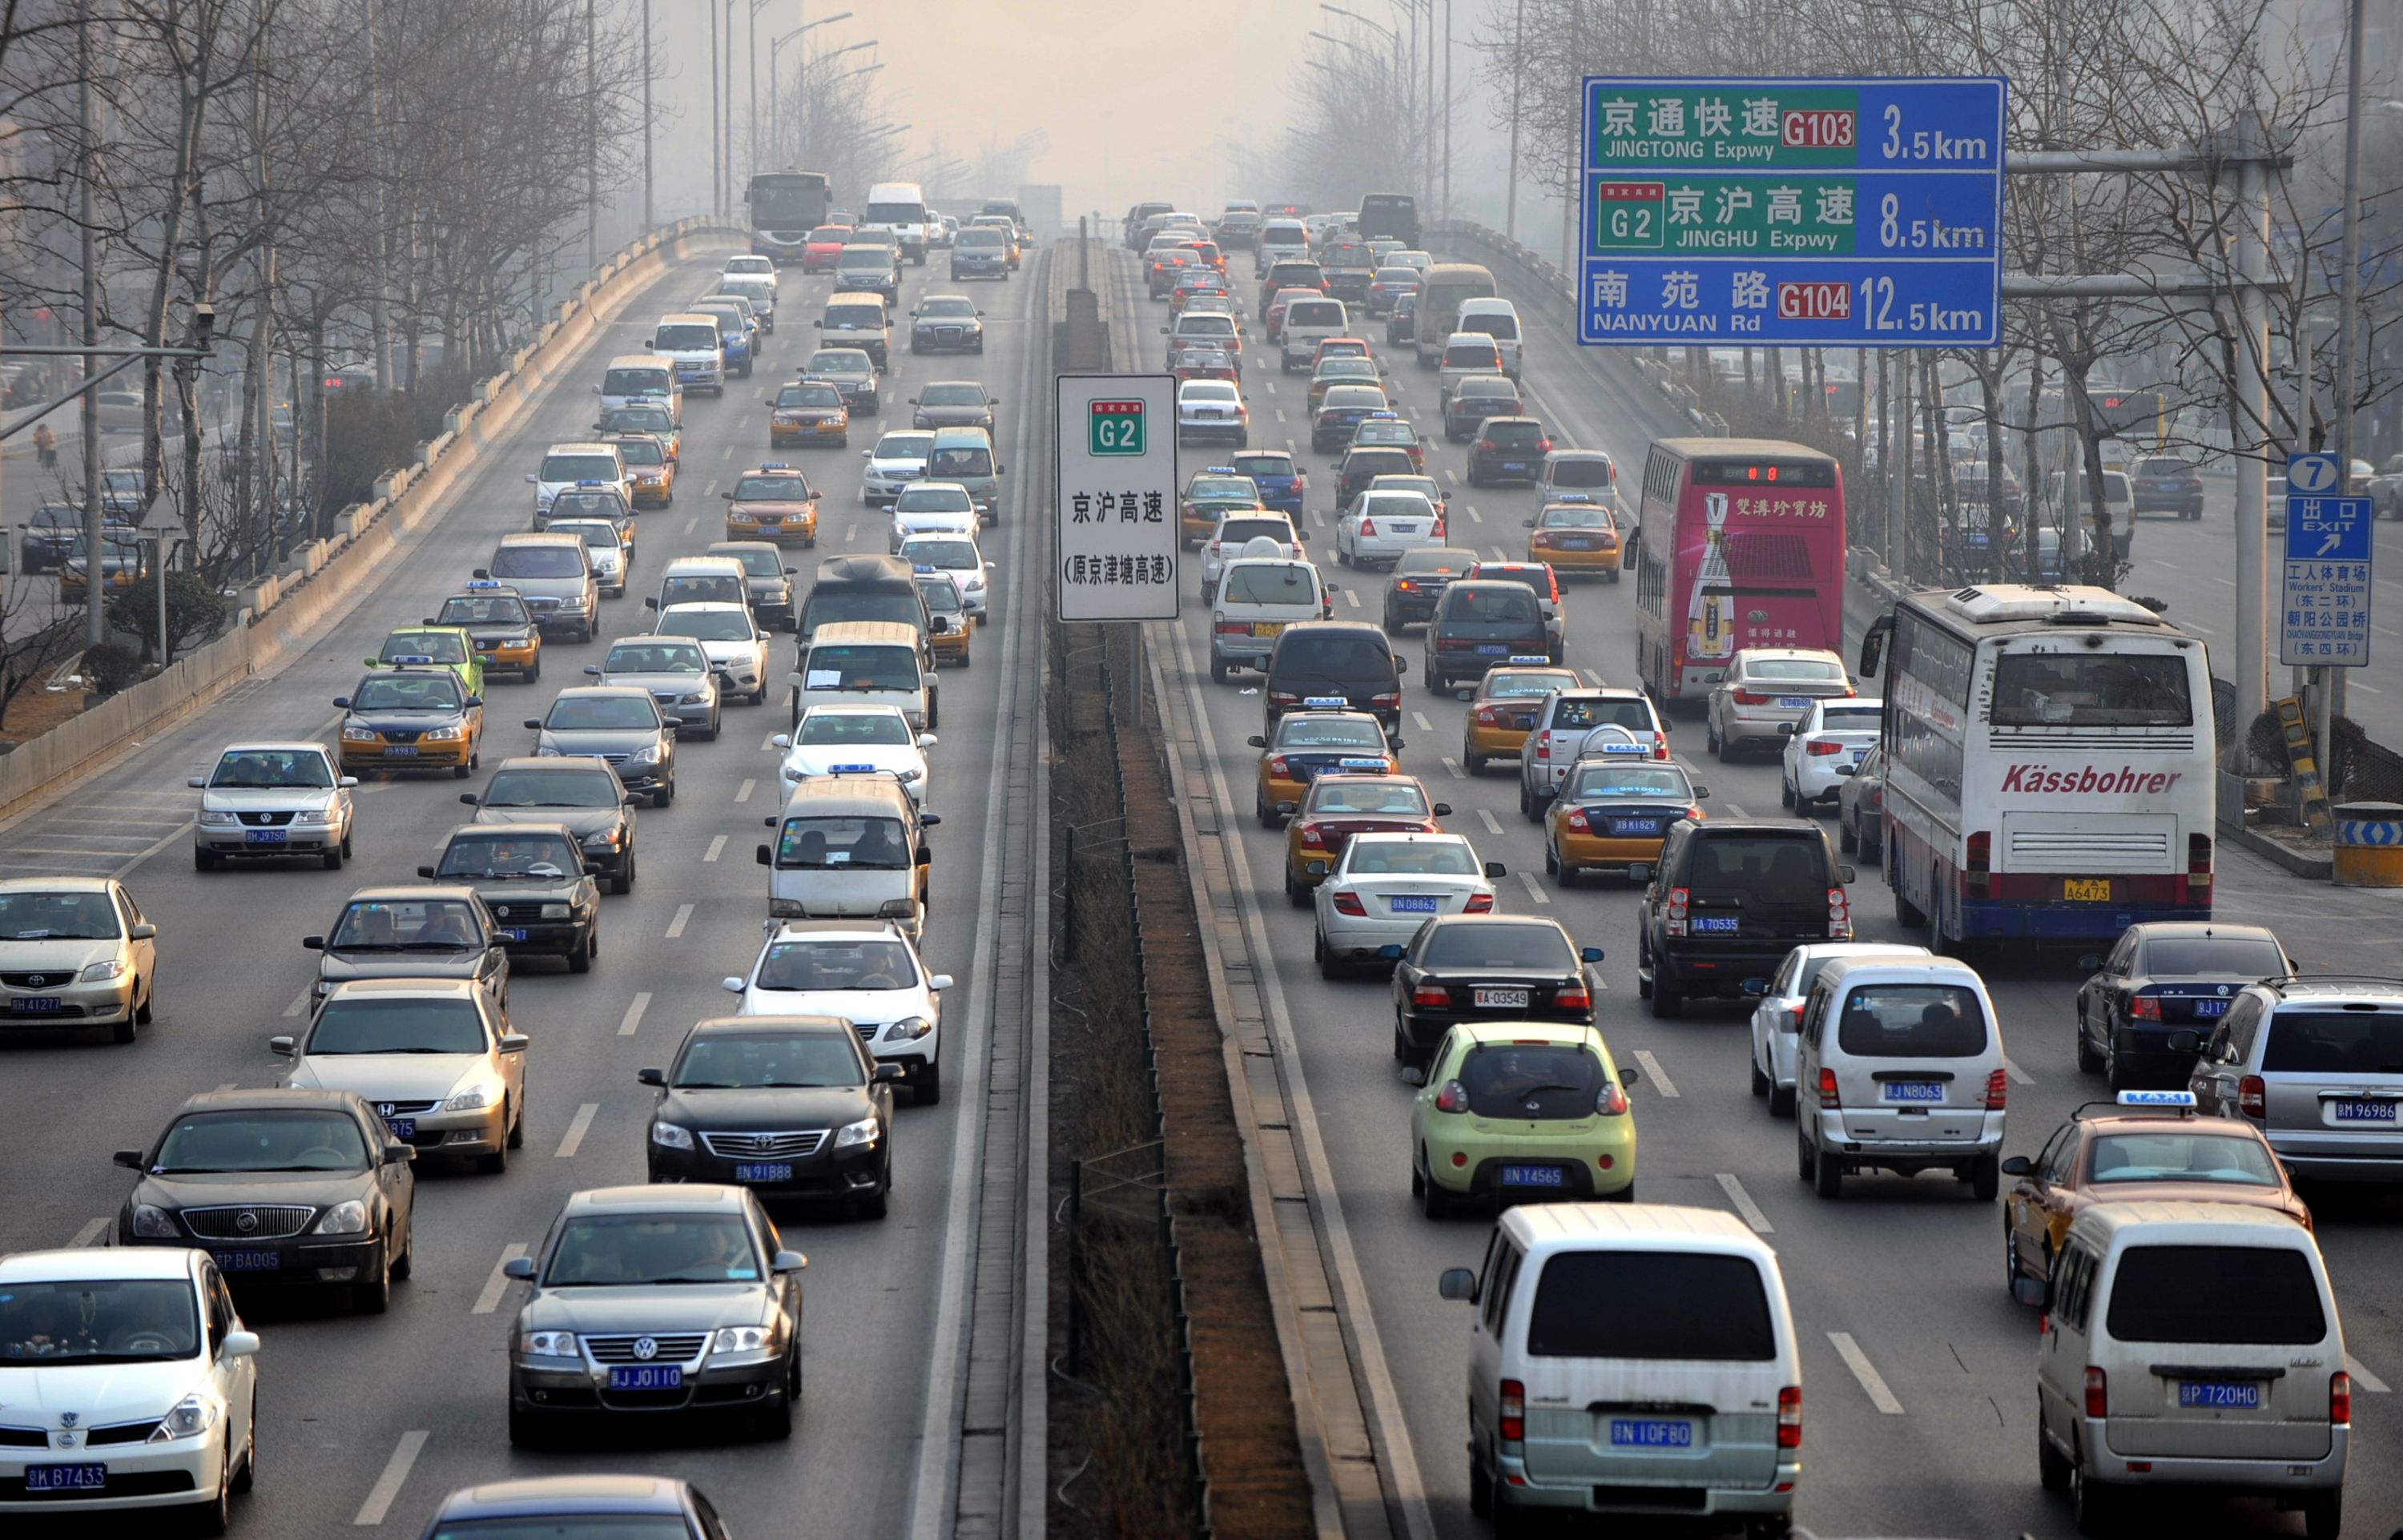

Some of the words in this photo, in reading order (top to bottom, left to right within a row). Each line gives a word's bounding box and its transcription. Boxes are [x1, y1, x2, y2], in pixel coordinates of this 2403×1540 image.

[1601, 97, 1779, 137] 京通快速
[1784, 111, 1853, 146] G103
[1605, 140, 1705, 159] JINGTONG
[1714, 140, 1774, 161] Expwy
[1668, 185, 1854, 225] 京沪高速
[1612, 209, 1651, 238] G2
[1676, 230, 1757, 248] JINGHU
[1770, 230, 1838, 251] Expwy
[1592, 269, 1770, 309] 南苑路
[1780, 284, 1848, 317] G104
[1594, 313, 1717, 332] NANYUAN
[1731, 314, 1761, 332] Rd
[1099, 420, 1135, 446] G2
[2306, 461, 2323, 488] 7
[1072, 489, 1163, 524] 京沪高速
[2302, 500, 2357, 520] 出口
[2302, 521, 2355, 532] EXIT
[2288, 565, 2366, 582] 工人体育场
[2330, 583, 2365, 593] Stadium
[2288, 610, 2365, 629] 朝阳公园桥
[1608, 744, 1646, 752] TAXI
[2001, 764, 2181, 794] Kässbohrer
[260, 830, 285, 842] J9750
[2067, 887, 2108, 900] A6473
[1406, 897, 1435, 911] D8862
[1708, 919, 1738, 931] 70535
[29, 998, 60, 1011] 41277
[1904, 1083, 1941, 1098] N8063
[2132, 1092, 2185, 1101] TAXI
[2358, 1102, 2394, 1118] 96986
[1523, 1168, 1560, 1183] Y4565
[634, 1369, 679, 1386] J0110
[2204, 1385, 2256, 1405] 720H0
[52, 1464, 104, 1486] B7433
